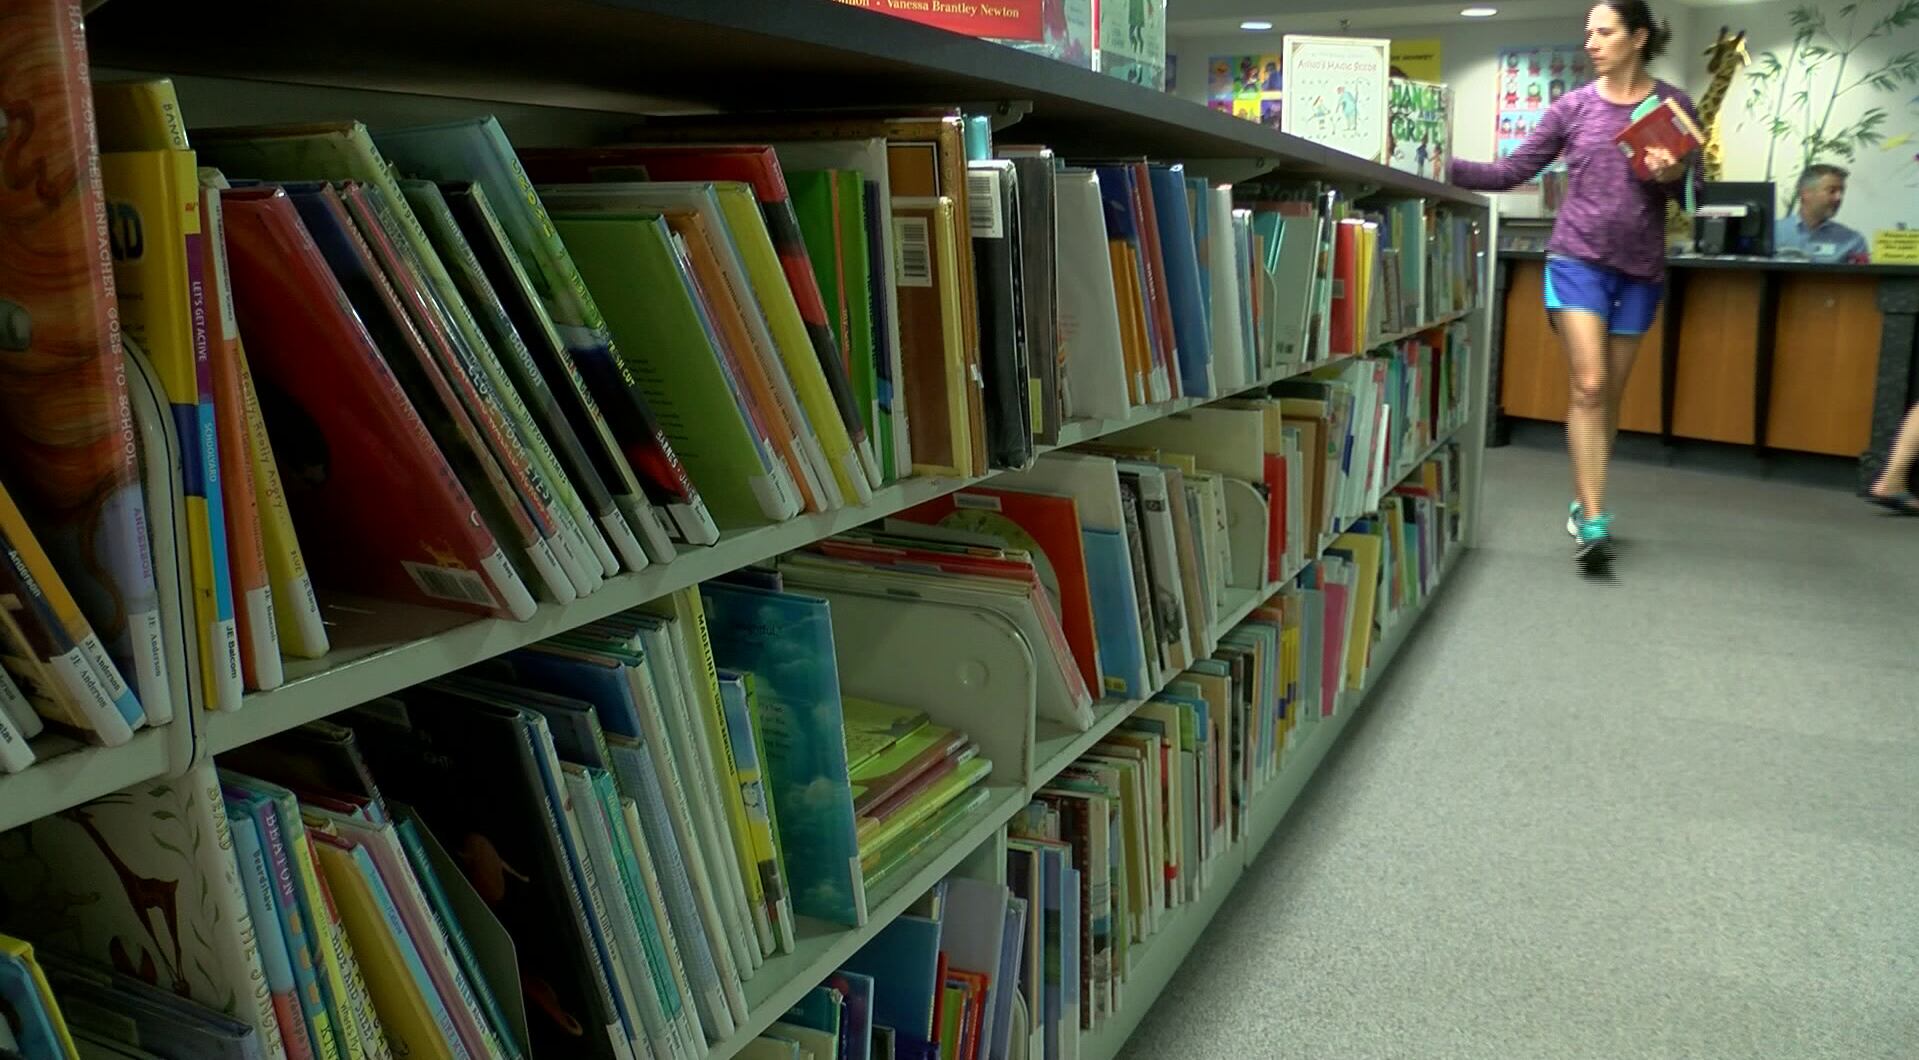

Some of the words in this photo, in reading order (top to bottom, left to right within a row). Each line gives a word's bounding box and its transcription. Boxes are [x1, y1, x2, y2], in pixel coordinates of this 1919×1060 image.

[67, 3, 84, 51] HAIR
[887, 0, 929, 11] Vanessa
[933, 1, 977, 17] Brantley
[981, 4, 1020, 18] Newton
[75, 61, 88, 85] OF
[80, 96, 93, 132] ZOE
[162, 103, 182, 146] BANG
[192, 281, 203, 305] LET'S
[105, 307, 121, 353] GOES
[194, 308, 204, 326] GET
[196, 327, 207, 361] ACTIVE
[113, 362, 126, 385] TO
[620, 367, 636, 387] CUT
[116, 393, 137, 464] SCHOOL
[467, 365, 497, 415] CLOSE
[500, 418, 526, 460] YOUR
[523, 462, 551, 500] EYES
[495, 366, 512, 388] AND
[509, 390, 526, 411] THE
[522, 411, 568, 483] HIPPOPOTAMUS
[651, 428, 681, 467] BARNES
[133, 507, 150, 579] ANDERSON
[7, 549, 42, 598] Anderson
[147, 616, 155, 628] JE
[225, 625, 234, 638] JE
[84, 638, 97, 651] JE
[93, 653, 122, 691] Anderson
[149, 632, 161, 677] Anderson
[225, 640, 239, 678] Balcom
[694, 613, 718, 679] MADELINE
[69, 653, 83, 667] JE
[78, 668, 110, 708] Anderson
[265, 813, 295, 896] BEATON
[252, 848, 273, 912] Beardshaw
[342, 970, 359, 1000] AND
[250, 967, 281, 1056] JUNGLE
